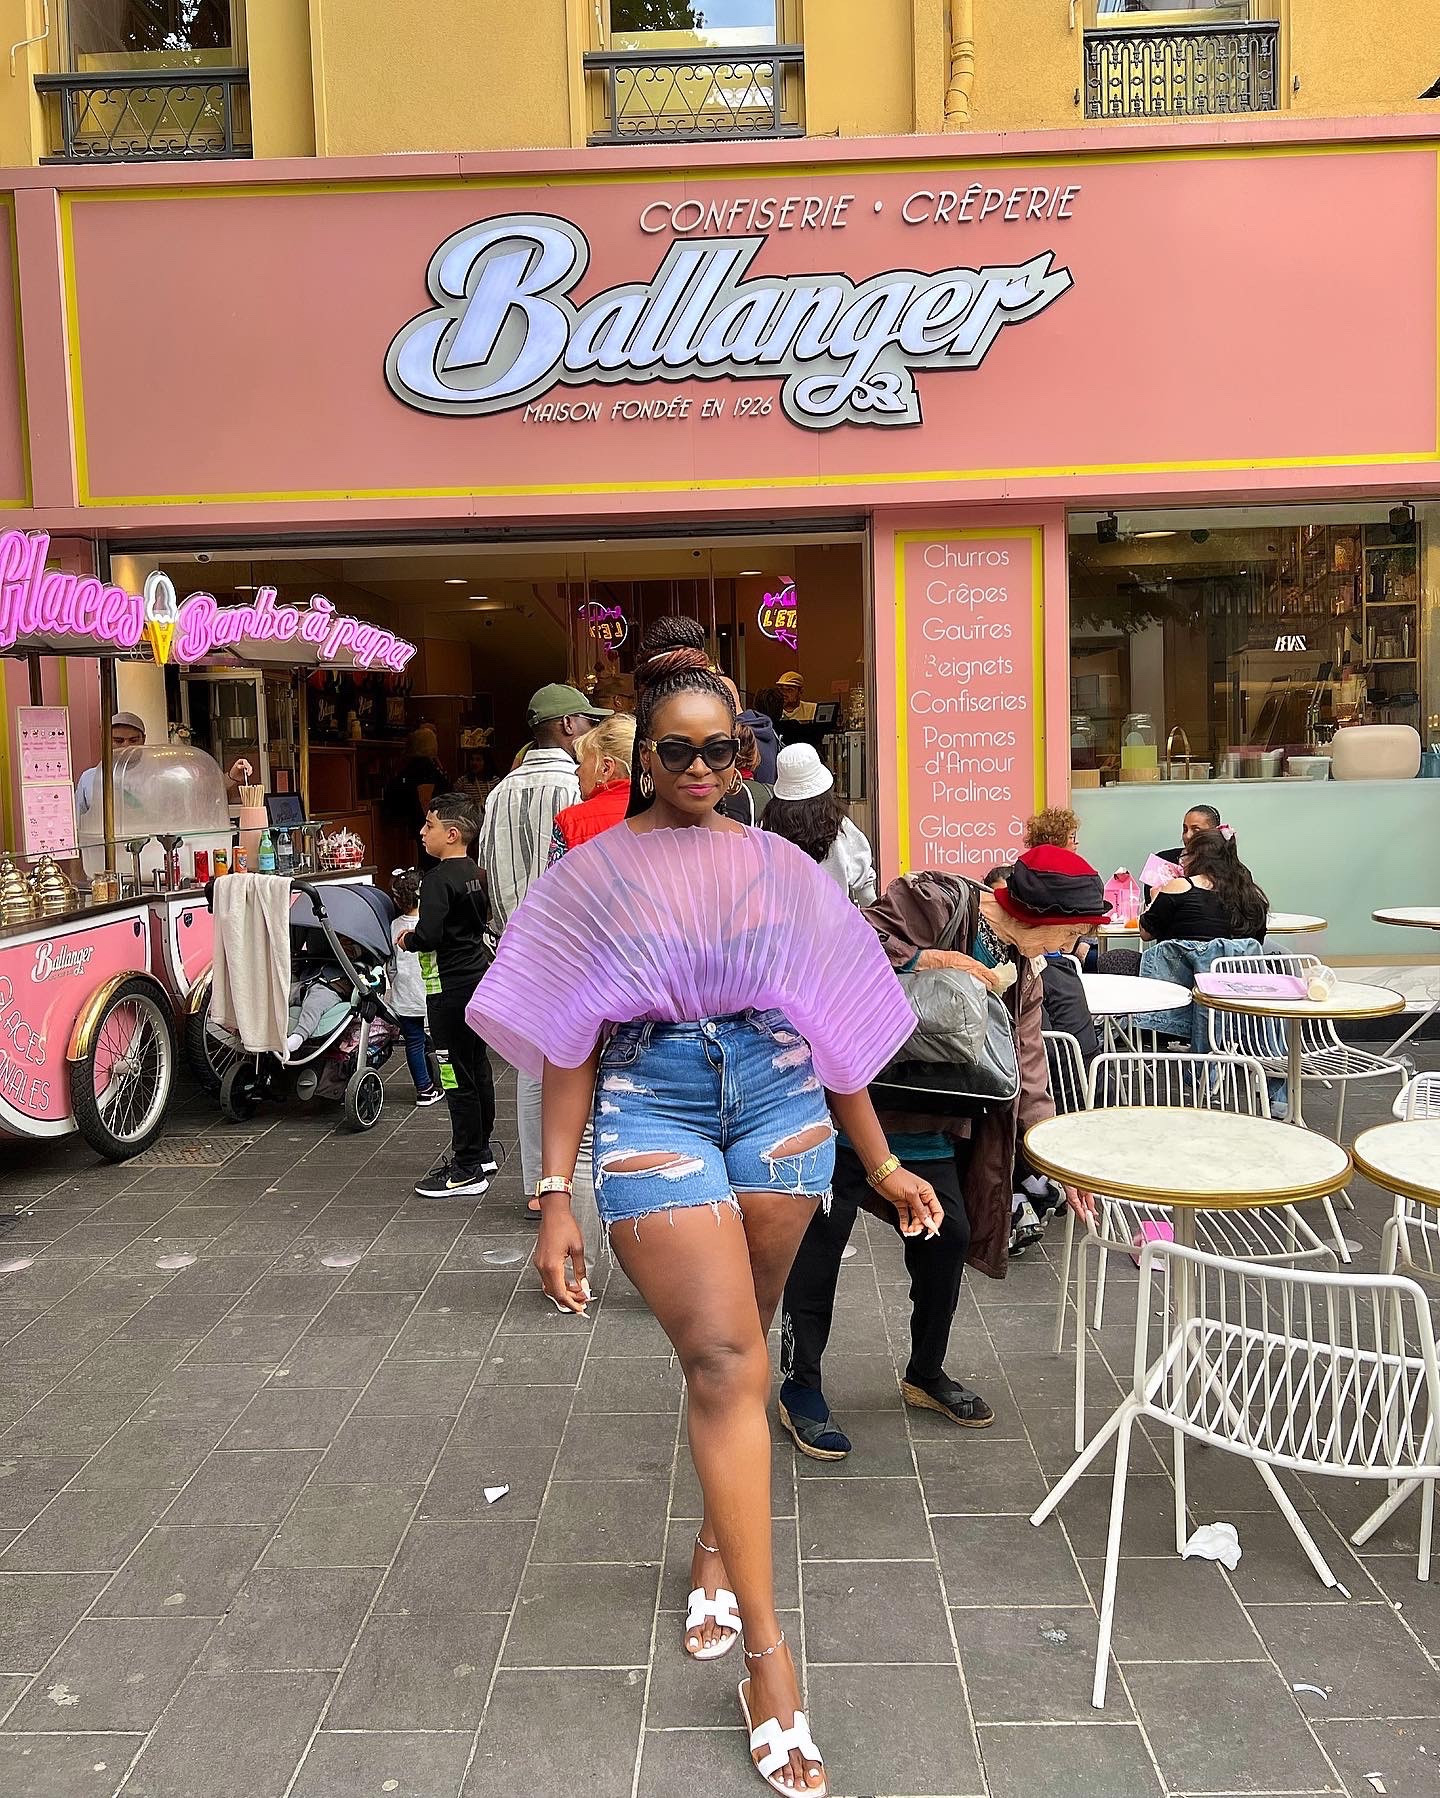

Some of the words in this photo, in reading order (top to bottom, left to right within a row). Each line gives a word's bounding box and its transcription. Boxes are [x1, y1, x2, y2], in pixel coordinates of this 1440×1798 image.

[640, 194, 856, 233] CONFISERIE
[902, 183, 1082, 223] CRÊPERIE
[387, 215, 1070, 425] Ballanger
[522, 401, 603, 423] MAISON
[611, 395, 693, 419] FONDÉE
[701, 398, 727, 417] EN
[733, 396, 774, 416] 1926
[924, 544, 1010, 568] Churros
[926, 580, 1008, 612] Crêpes
[177, 590, 300, 662] Barbe
[302, 597, 335, 642] à
[323, 617, 416, 671] papa
[922, 616, 1012, 641] Gaufres
[910, 688, 1027, 714] Confiseries
[923, 726, 1016, 748] Pommes
[925, 751, 1016, 775] d'Amour
[932, 779, 1012, 803] Pralines
[919, 815, 997, 838] Glaces
[1008, 814, 1024, 836] à
[925, 841, 1020, 865] l'Italienne
[31, 941, 95, 983] Ballanger
